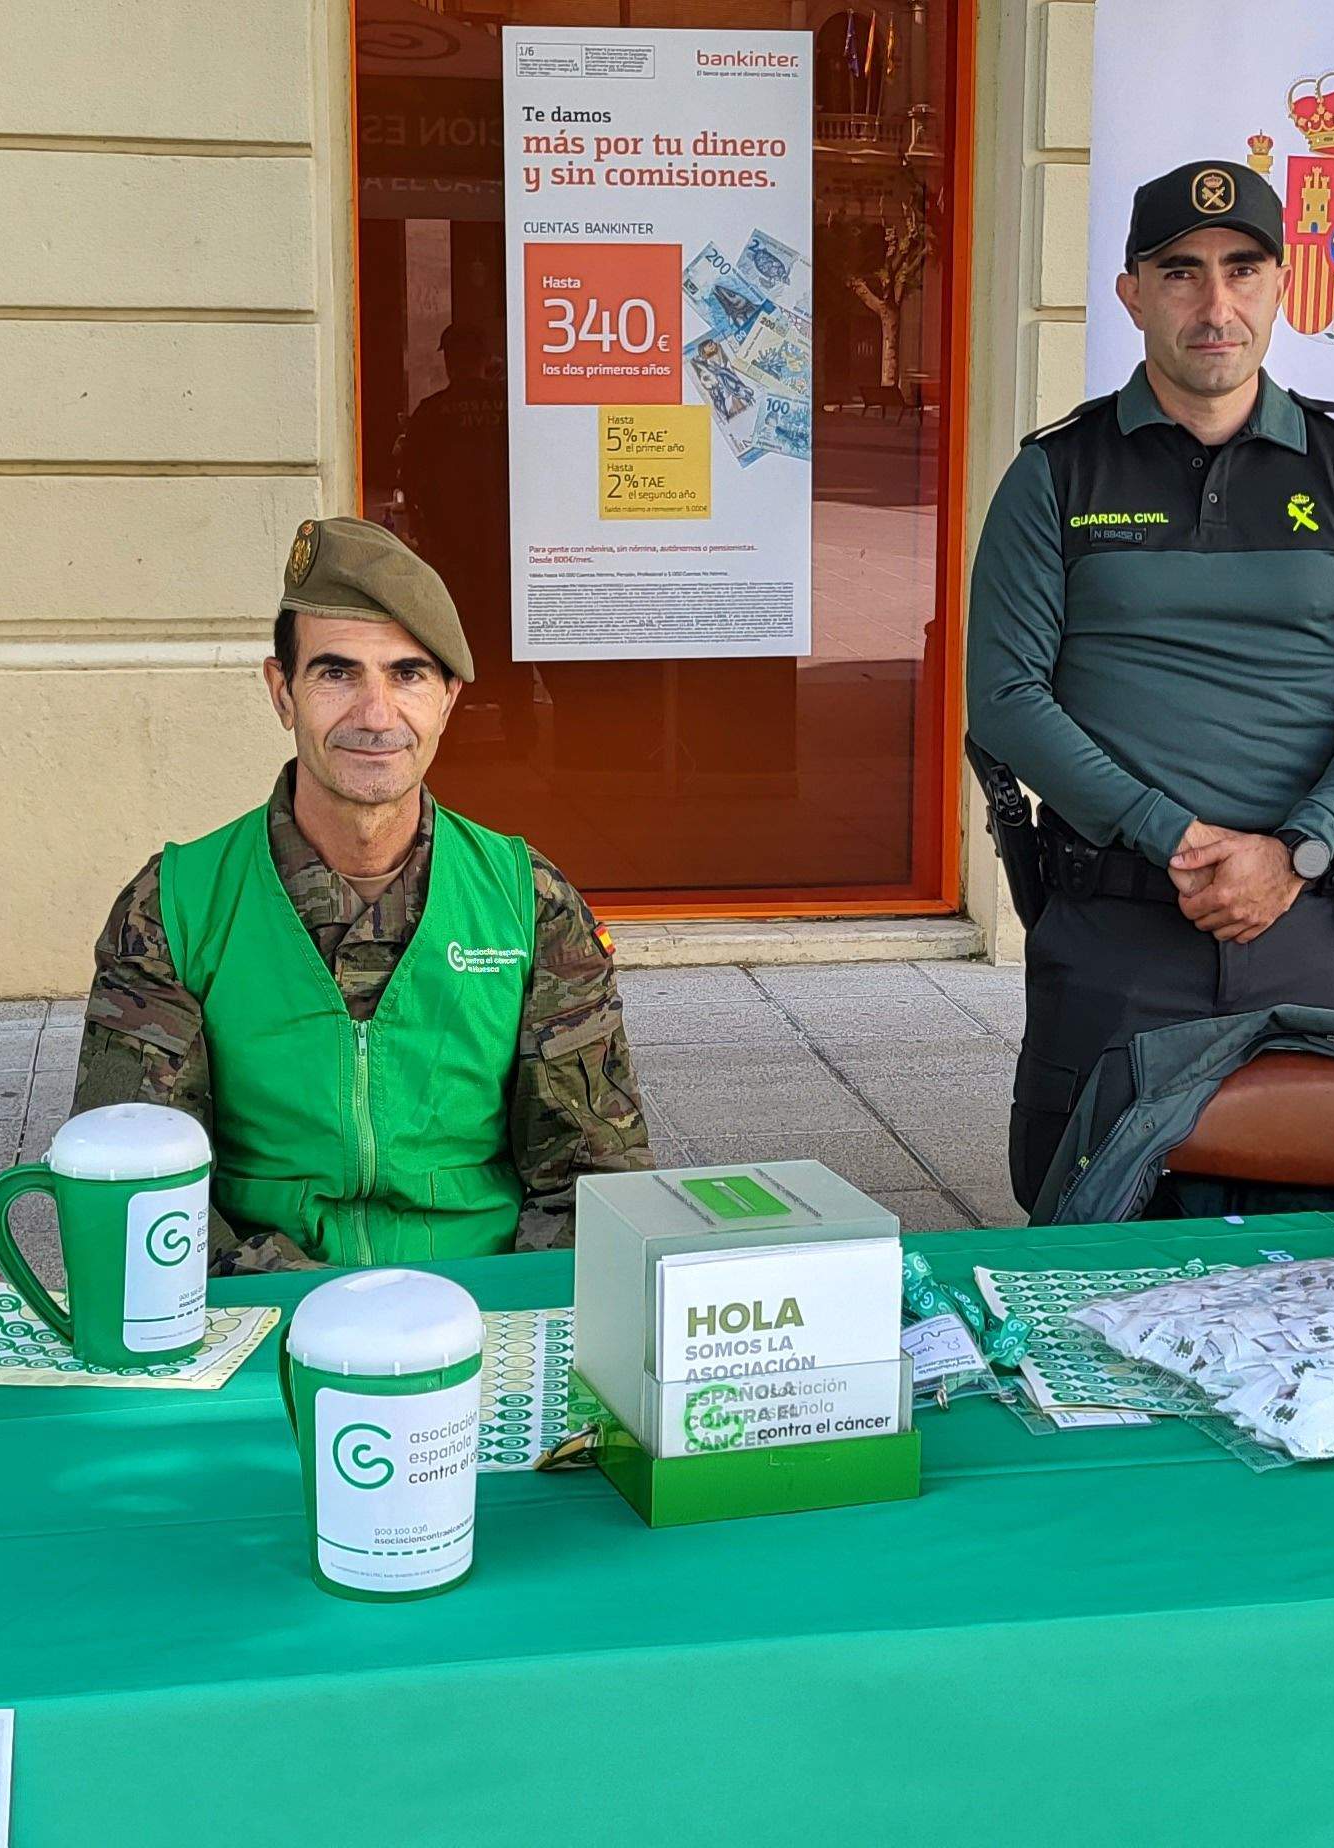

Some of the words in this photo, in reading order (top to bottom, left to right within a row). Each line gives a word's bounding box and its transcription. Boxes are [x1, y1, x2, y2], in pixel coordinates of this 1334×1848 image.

[519, 46, 535, 57] 1/6
[696, 49, 799, 68] bankinter.
[522, 106, 545, 122] Te
[551, 106, 612, 123] damos
[523, 130, 585, 154] más
[594, 135, 644, 162] por
[652, 133, 684, 156] tu
[692, 131, 787, 157] dinero
[523, 165, 541, 193] y
[551, 160, 596, 186] sin
[605, 162, 776, 188] comisiones.
[523, 221, 579, 234] CUENTAS
[585, 222, 654, 235] BANKINTER
[705, 247, 732, 276] 200
[542, 276, 581, 289] Hasta
[542, 363, 561, 376] los
[562, 363, 585, 376] dos
[586, 363, 641, 378] primeros
[642, 364, 671, 376] años
[607, 415, 634, 425] Hasta
[625, 444, 634, 453] el
[635, 444, 666, 455] primer
[667, 443, 685, 453] año
[607, 463, 634, 473] Hasta
[640, 476, 666, 488] TAE
[628, 491, 637, 500] el
[638, 490, 677, 502] segundo
[678, 490, 697, 499] año
[1070, 513, 1132, 528] GUARDIA
[1134, 512, 1169, 524] CIVIL
[529, 545, 547, 553] Para
[547, 546, 569, 555] gente
[585, 545, 615, 554] nómina,
[616, 545, 627, 553] sin
[628, 545, 658, 553] nómina,
[529, 556, 553, 564] Desde
[687, 1297, 805, 1338] HOLA
[685, 1338, 762, 1361] SOMOS
[768, 1335, 794, 1353] LA
[685, 1352, 816, 1385] ASOCIACIÓN
[685, 1381, 796, 1409] ESPAÑOLA
[409, 1411, 478, 1444] asociación
[685, 1408, 772, 1433] CONTRA
[758, 1422, 811, 1440] contra
[816, 1418, 830, 1434] el
[834, 1415, 892, 1432] cáncer
[409, 1434, 472, 1466] española
[408, 1463, 458, 1484] contra
[460, 1453, 469, 1470] el
[394, 1527, 410, 1536] 100
